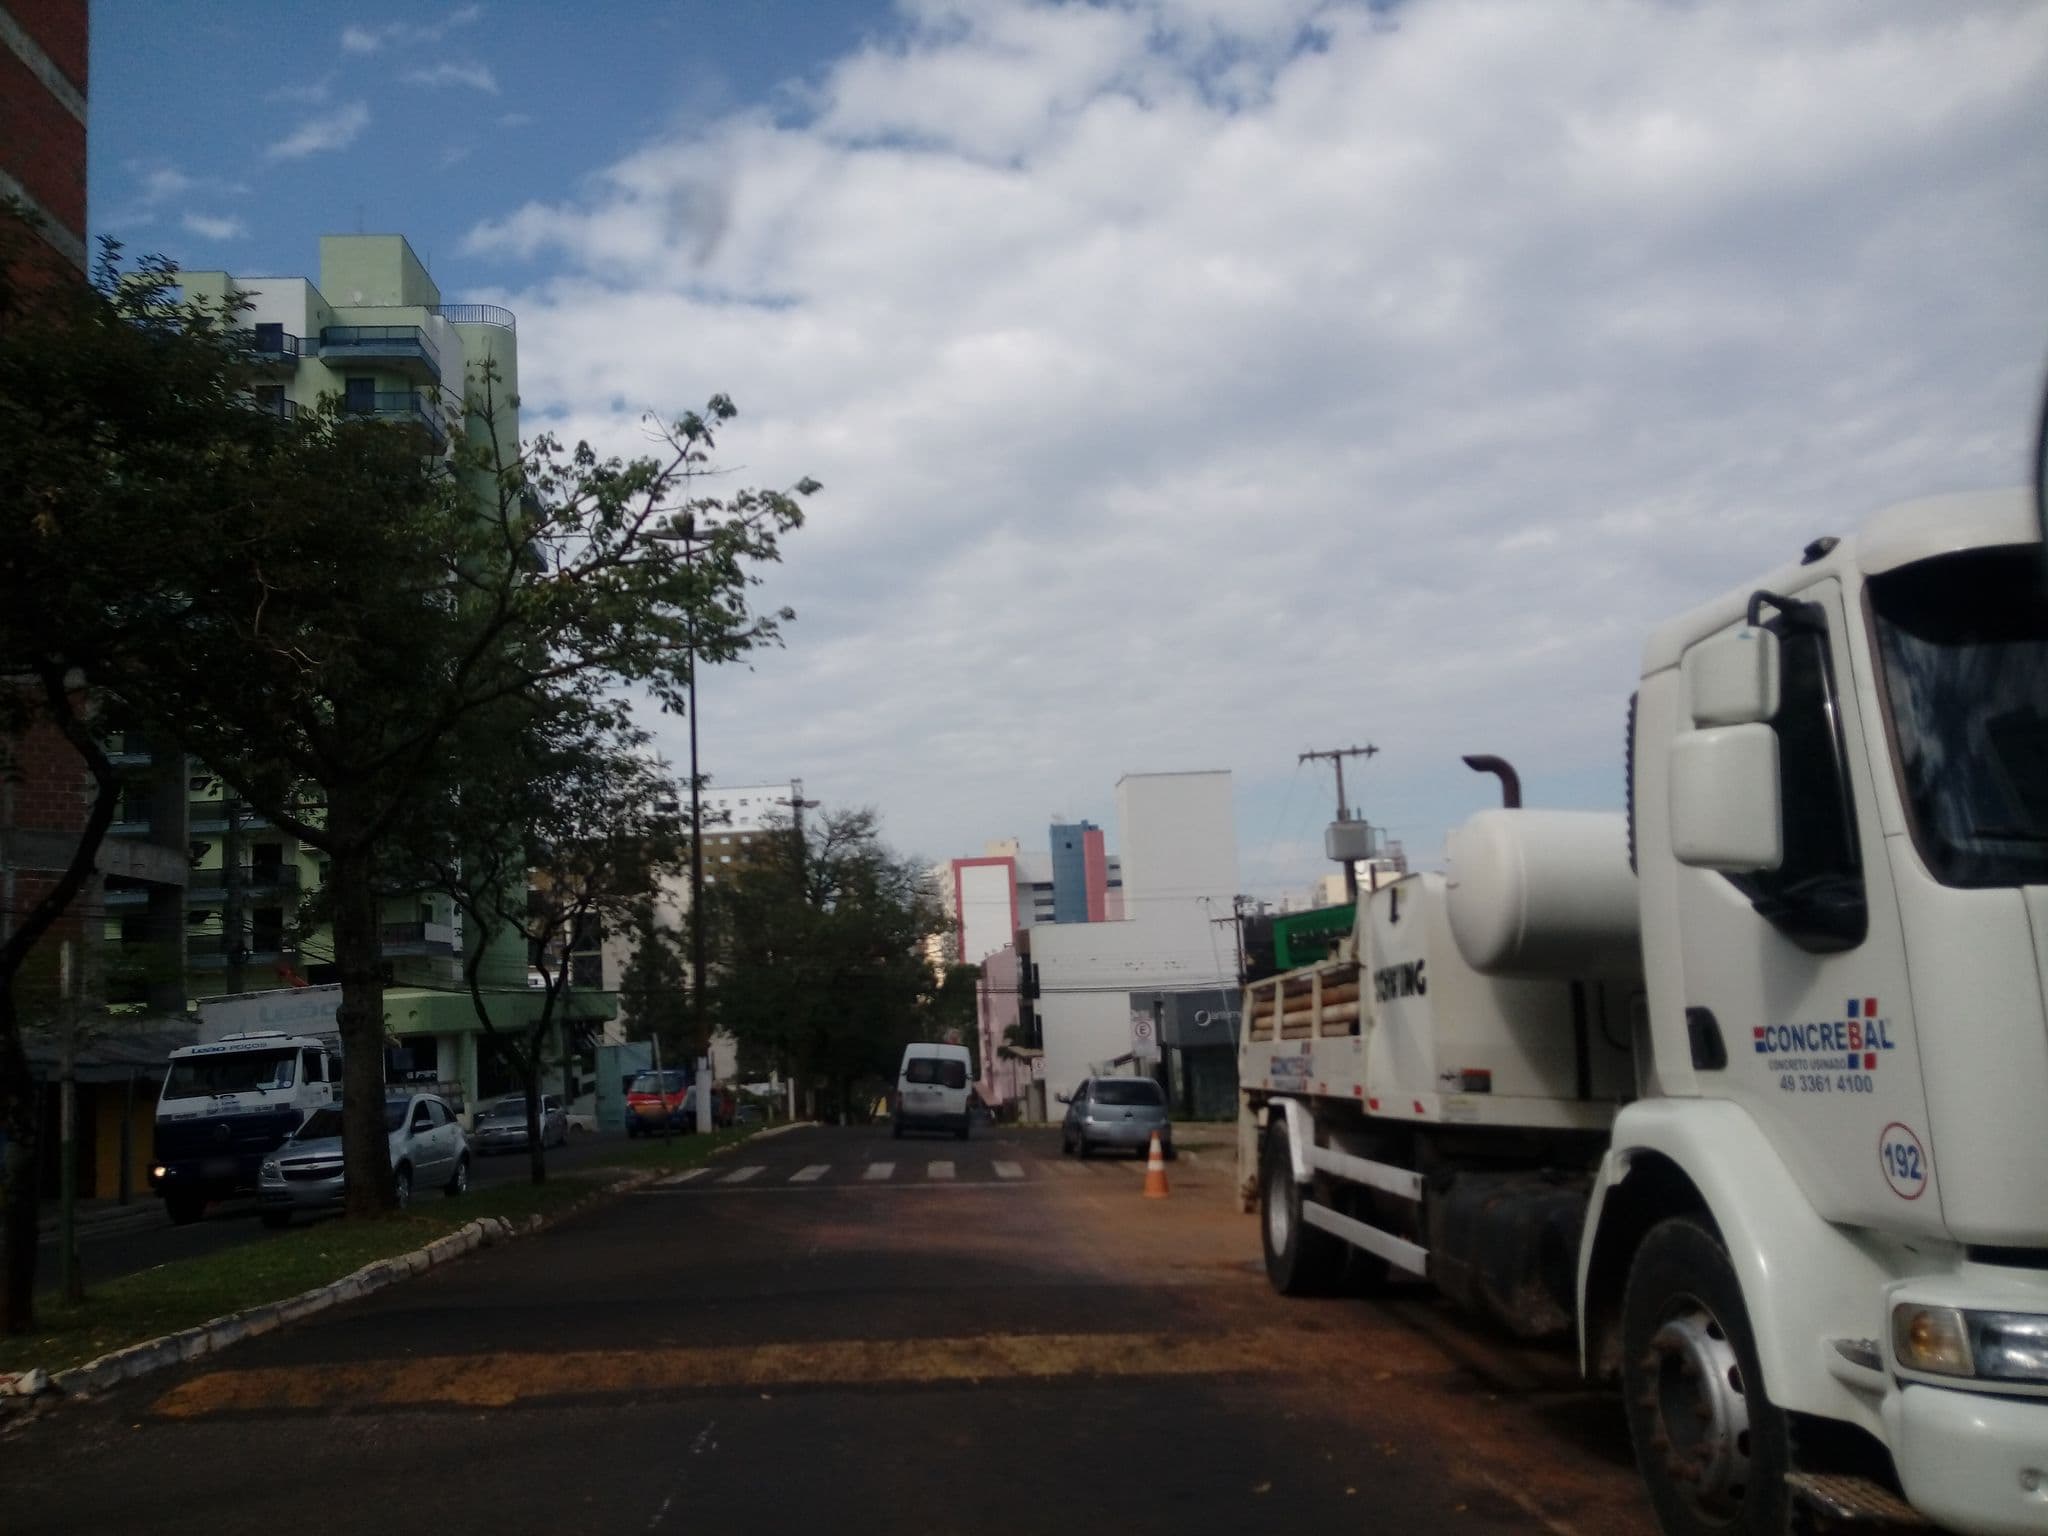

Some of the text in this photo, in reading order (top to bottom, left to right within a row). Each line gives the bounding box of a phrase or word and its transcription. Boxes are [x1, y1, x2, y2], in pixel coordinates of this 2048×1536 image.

[1140, 1025, 1147, 1035] E
[1766, 1020, 1895, 1052] CONCREBAL
[1768, 1058, 1808, 1070] CONCRETO
[1780, 1074, 1873, 1093] 49 3361 4100
[1884, 1143, 1922, 1180] 192
